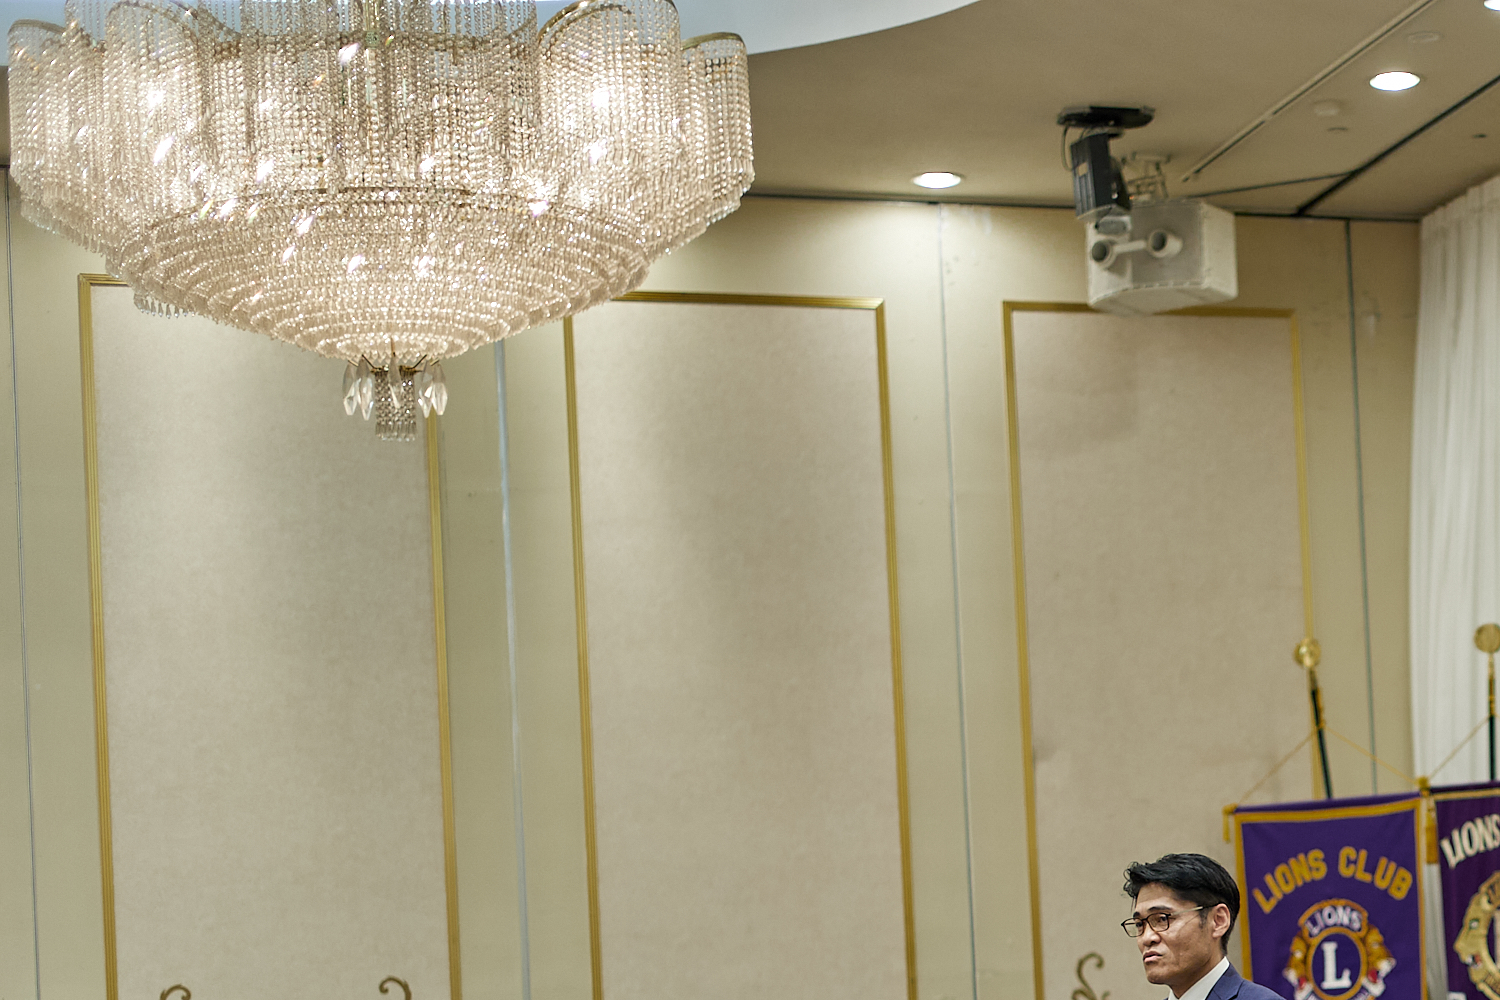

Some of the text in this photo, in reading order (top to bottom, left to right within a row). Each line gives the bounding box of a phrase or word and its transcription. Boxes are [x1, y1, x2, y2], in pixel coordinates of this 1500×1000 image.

[1252, 846, 1413, 914] LIONS CLUB
[1304, 905, 1362, 936] LIONS
[1320, 941, 1352, 989] L
